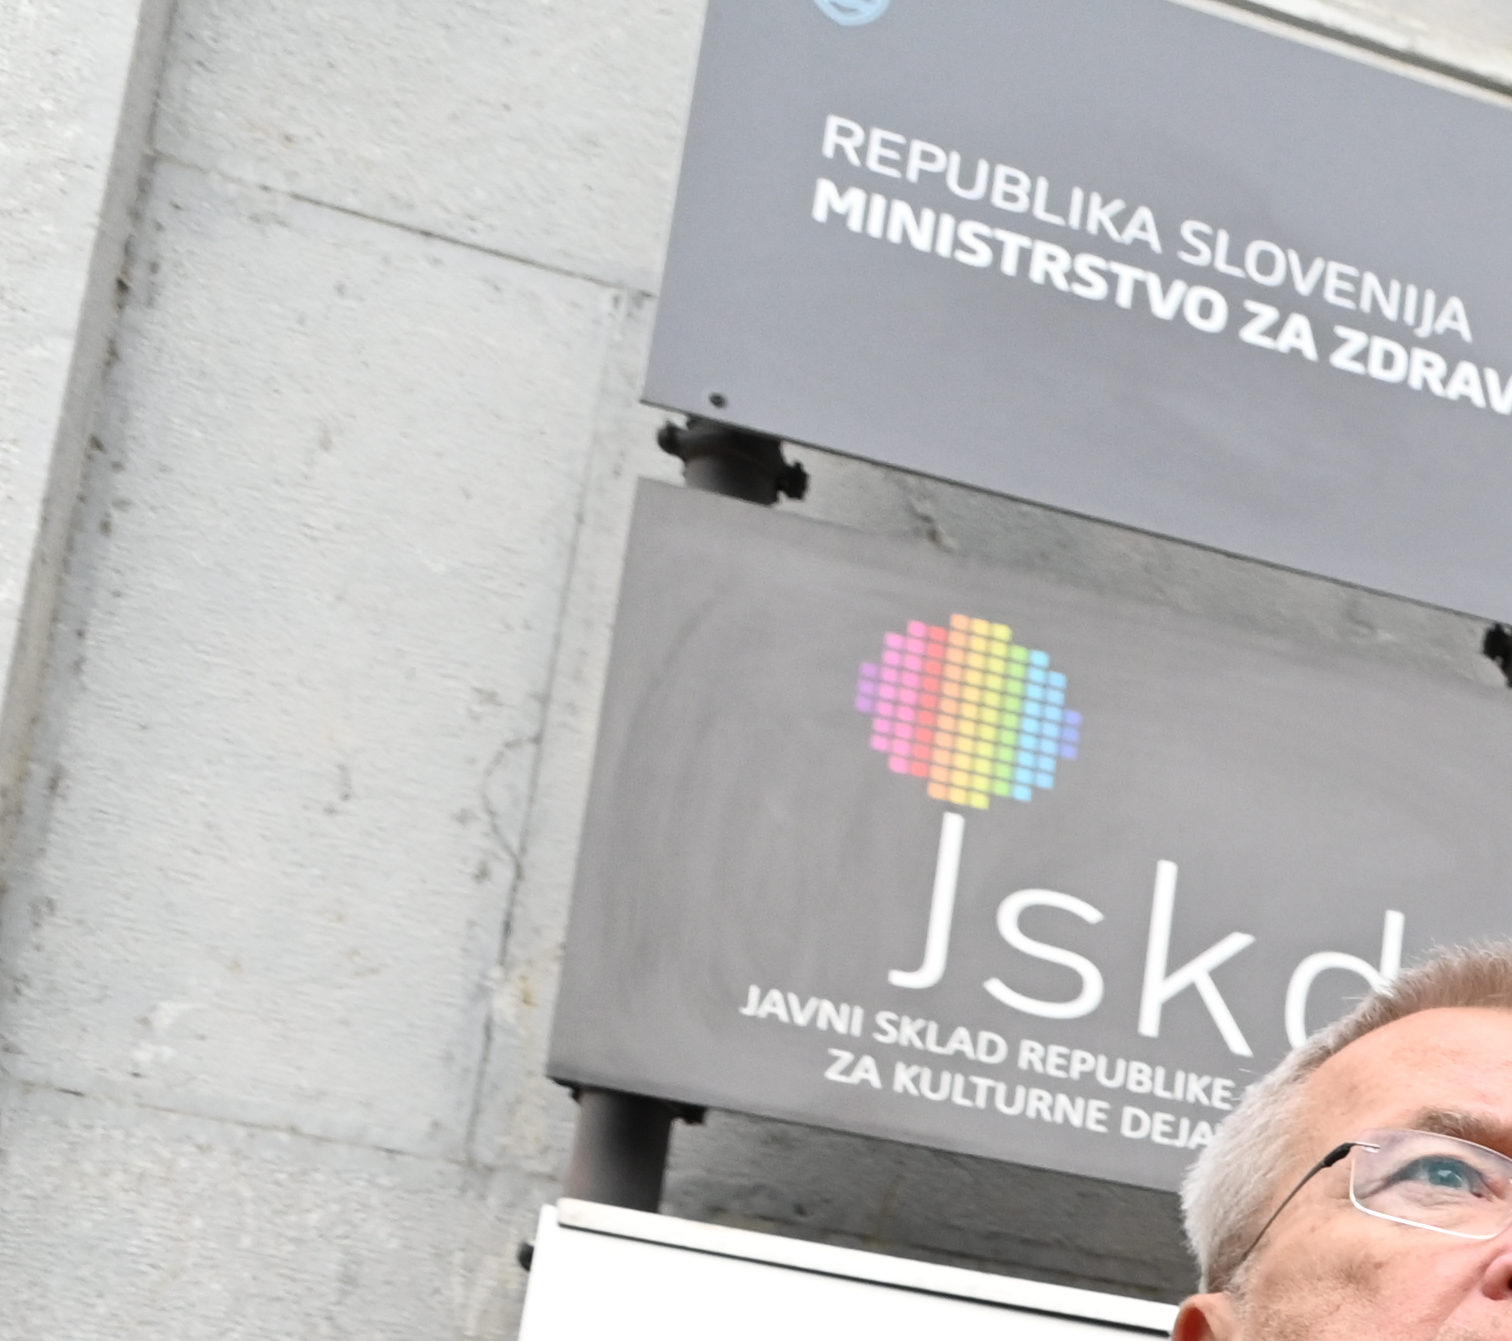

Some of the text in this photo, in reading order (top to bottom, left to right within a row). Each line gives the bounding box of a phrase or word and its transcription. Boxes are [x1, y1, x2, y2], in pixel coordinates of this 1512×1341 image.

[812, 177, 1229, 333] MINISTRSTVO
[1238, 299, 1318, 362] ZA
[821, 113, 1473, 343] REPUBLIKA SLOVENIJA
[739, 984, 1237, 1111] JAVNI SKLAD REPUBLIKE
[824, 1048, 1218, 1150] ZA KULTURNE DEJA
